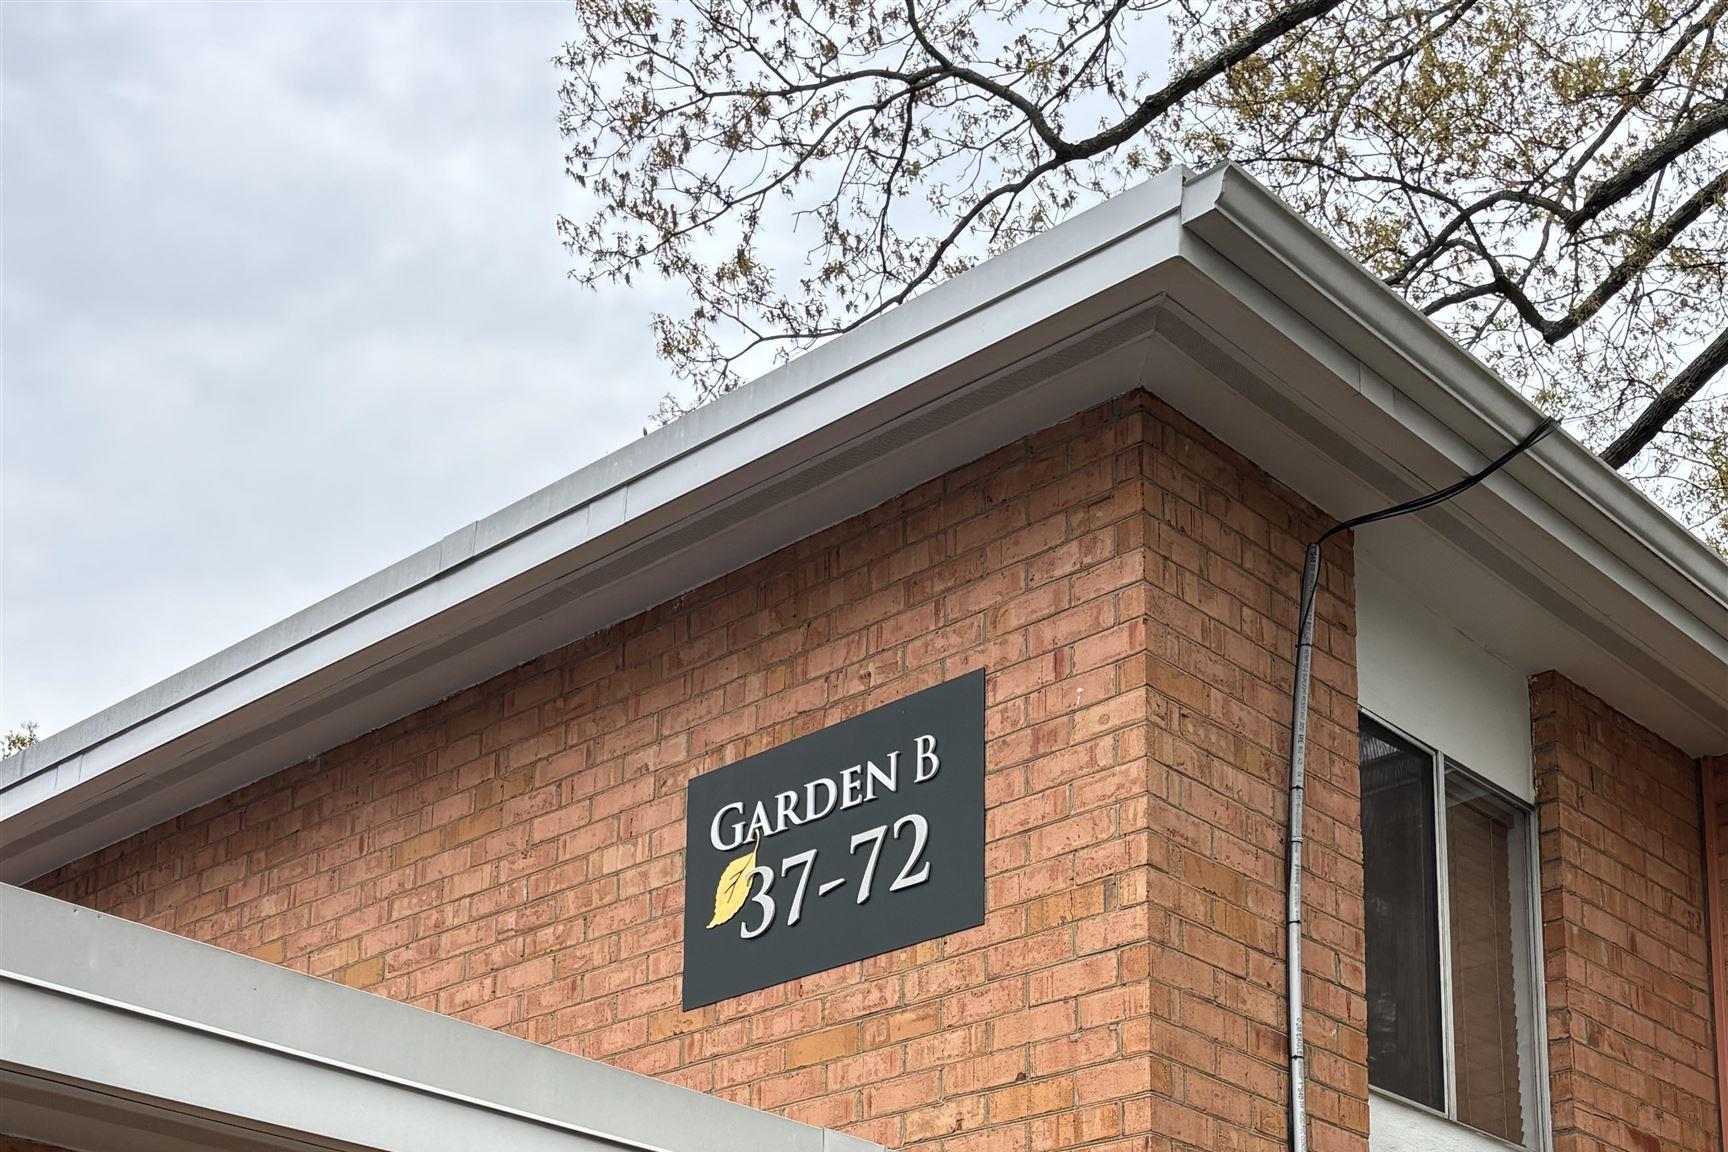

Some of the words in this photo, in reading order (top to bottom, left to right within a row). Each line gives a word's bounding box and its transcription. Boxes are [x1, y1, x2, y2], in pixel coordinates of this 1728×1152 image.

[710, 751, 900, 851] GARDEN
[914, 734, 940, 784] B
[740, 813, 931, 939] 37-72
